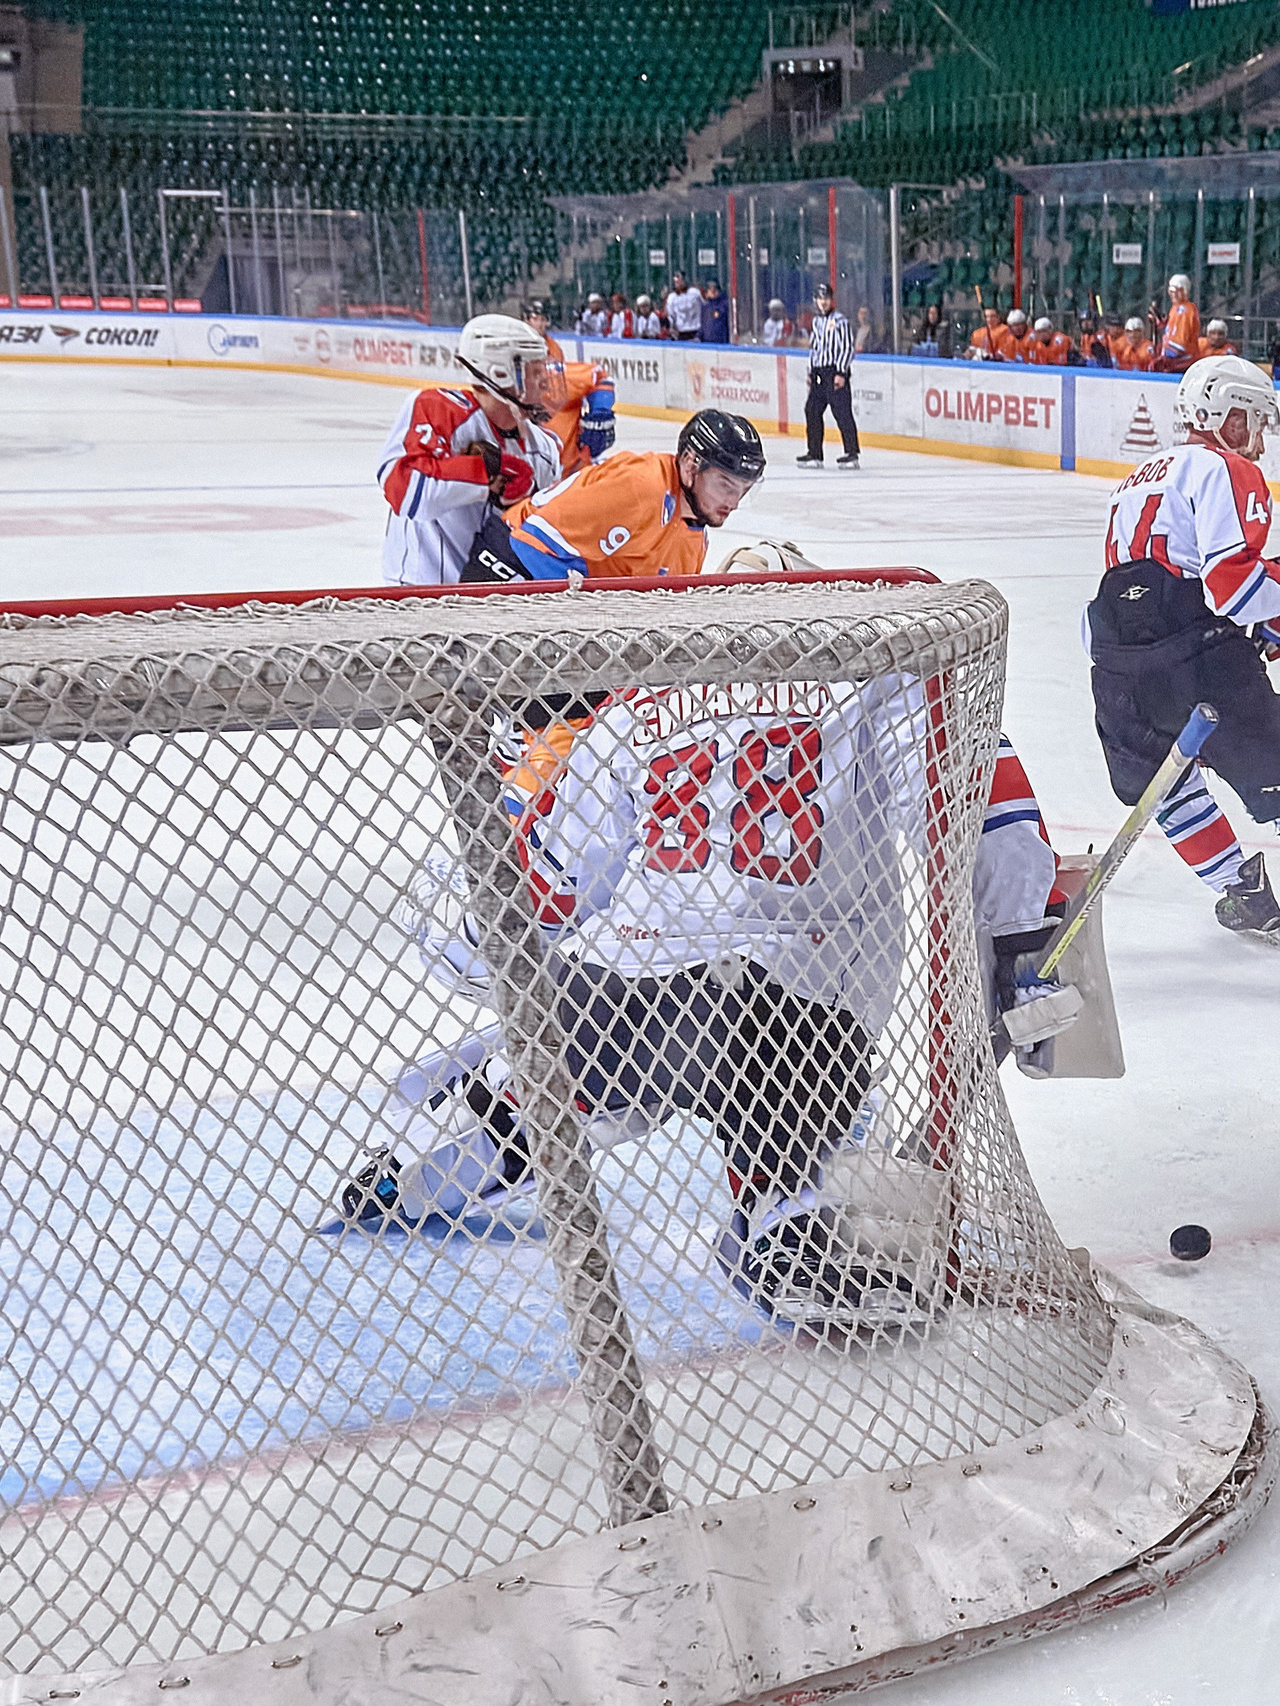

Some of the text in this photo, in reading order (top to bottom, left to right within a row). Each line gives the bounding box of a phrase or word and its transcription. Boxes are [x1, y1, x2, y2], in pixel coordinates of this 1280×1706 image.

[85, 327, 159, 347] СОКОЛ!
[353, 337, 413, 366] OLIMPBET
[622, 359, 659, 383] TYRES
[925, 387, 1056, 430] OLIMPBET
[599, 526, 631, 557] 9
[478, 550, 526, 582] CC
